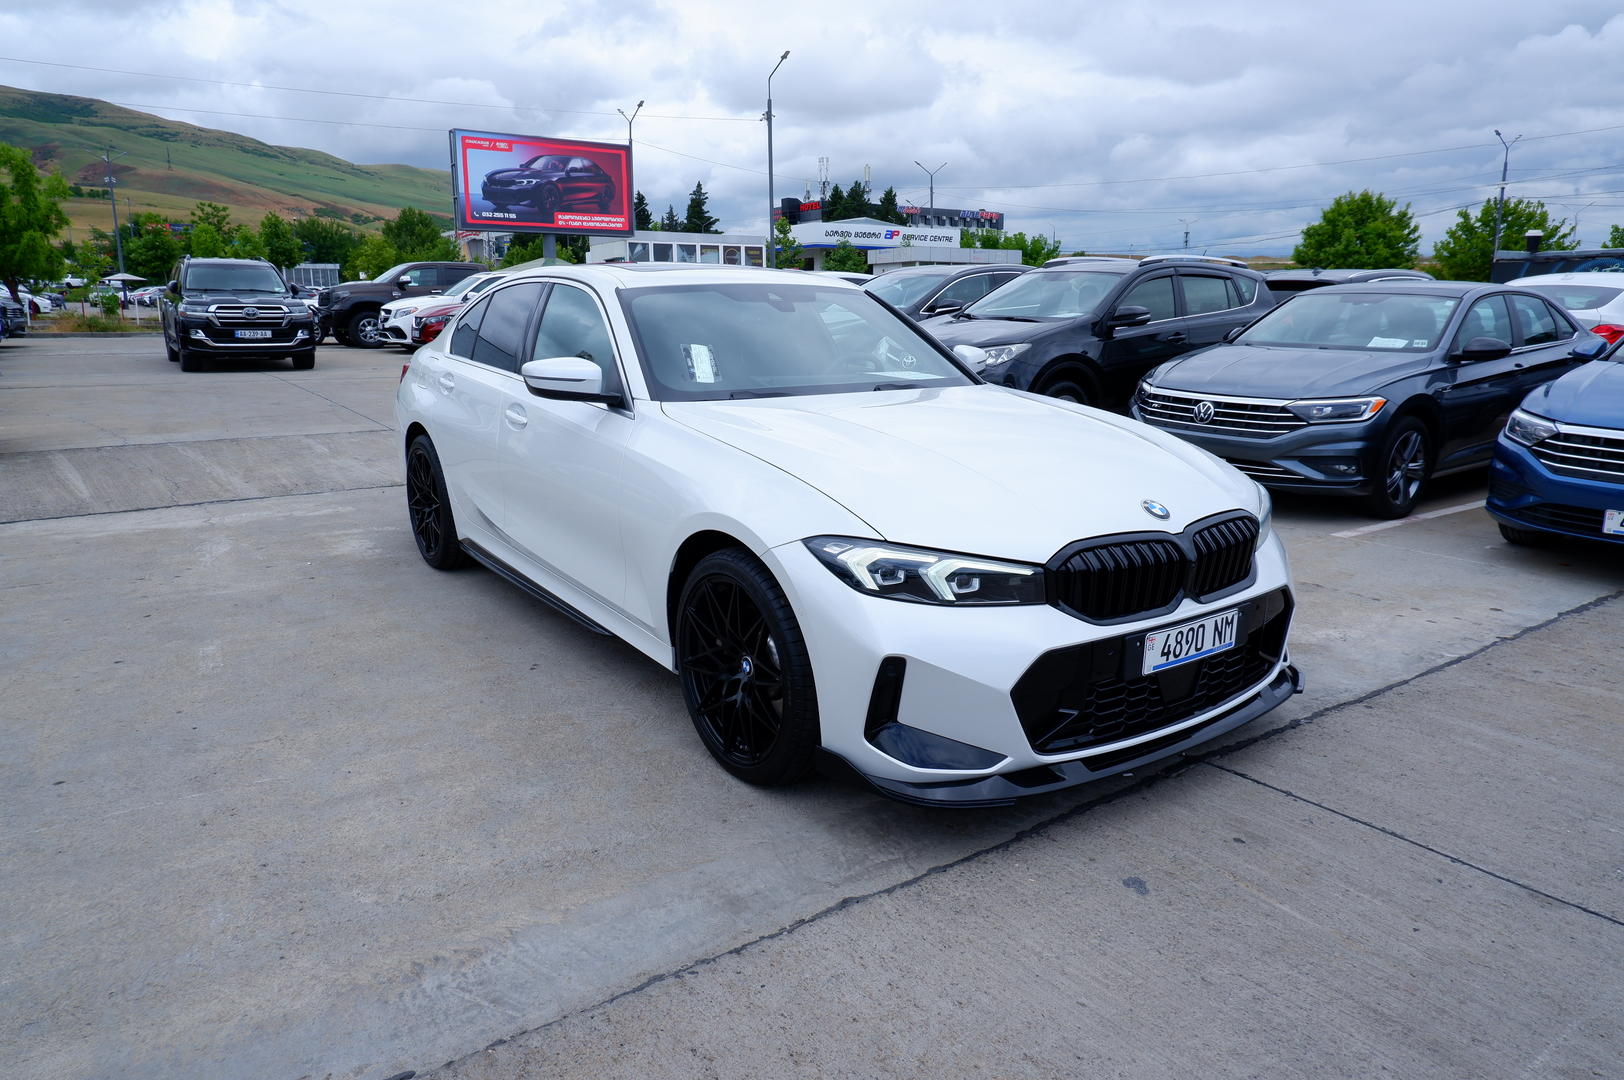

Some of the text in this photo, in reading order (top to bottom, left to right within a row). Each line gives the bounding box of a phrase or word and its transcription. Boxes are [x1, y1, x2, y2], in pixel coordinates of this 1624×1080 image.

[800, 202, 821, 211] HOTEL
[825, 230, 881, 239] სერვის ცენტრი
[902, 233, 954, 243] SERVICE CENTRE
[1160, 613, 1235, 662] 4890 NM
